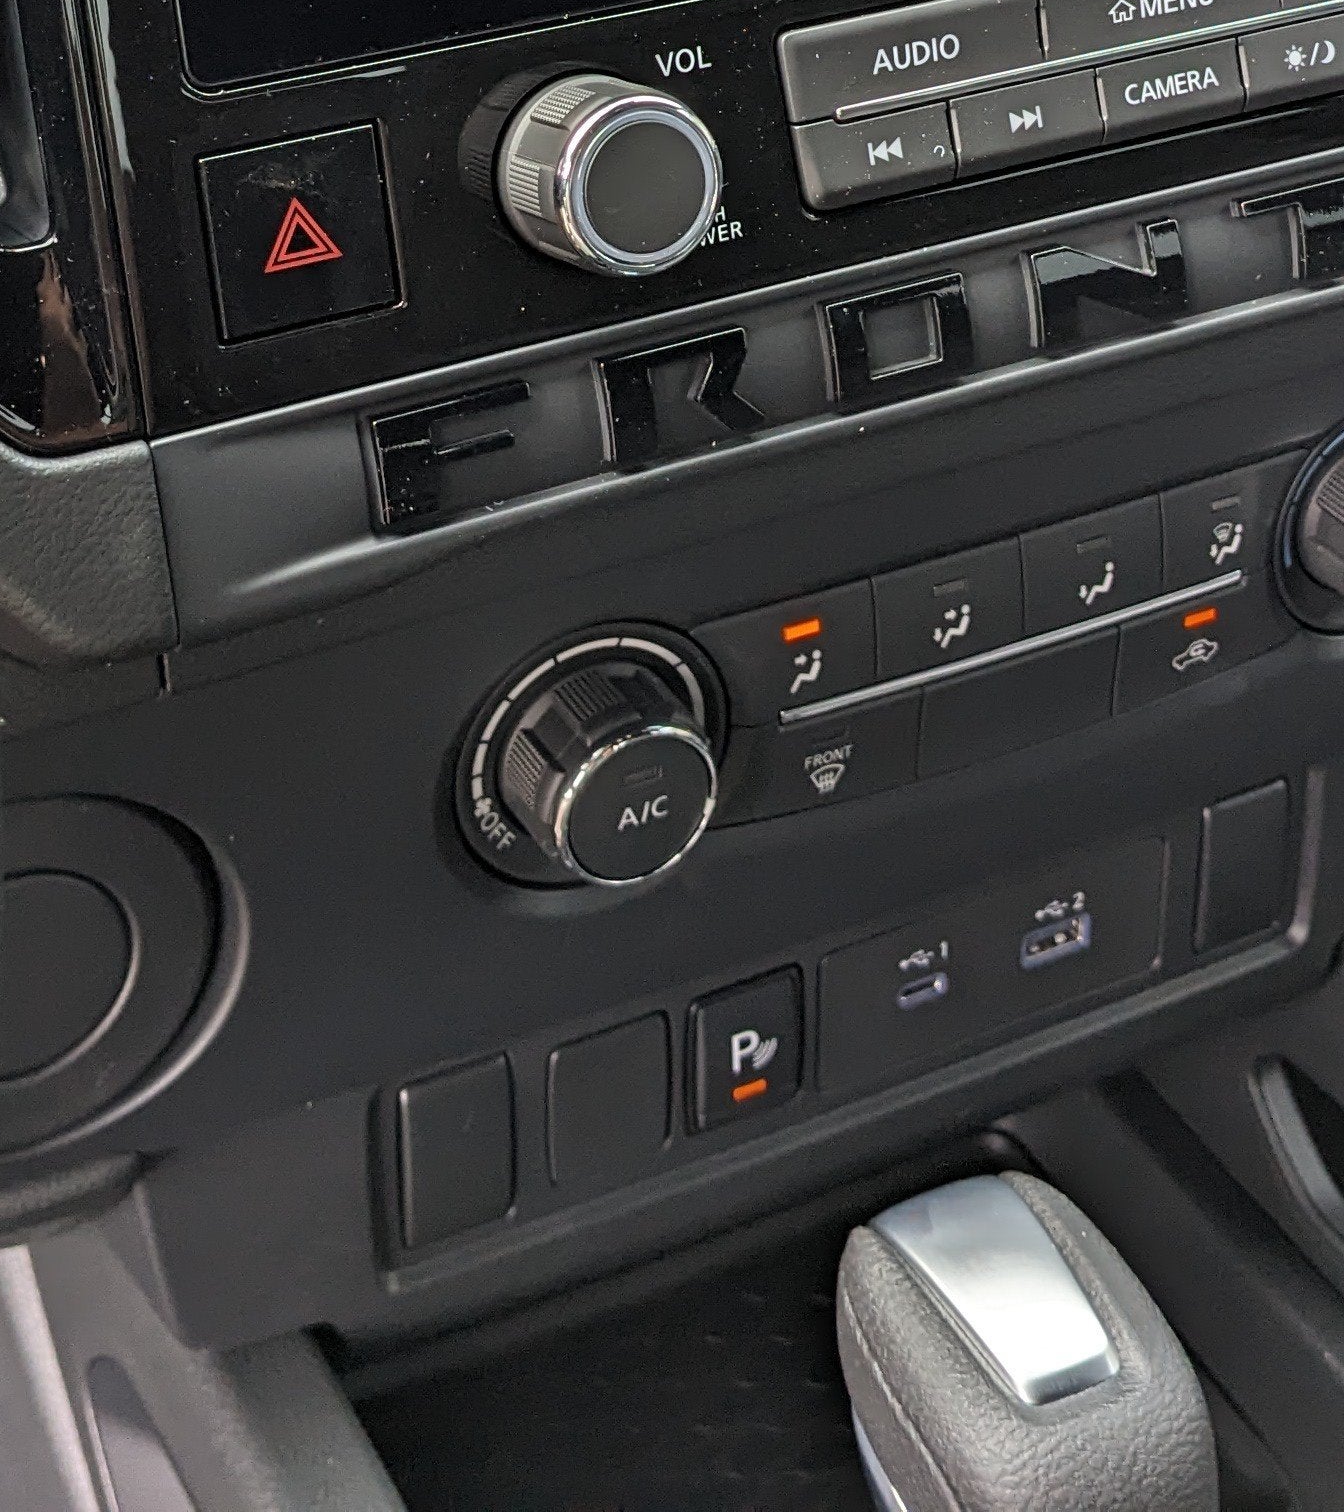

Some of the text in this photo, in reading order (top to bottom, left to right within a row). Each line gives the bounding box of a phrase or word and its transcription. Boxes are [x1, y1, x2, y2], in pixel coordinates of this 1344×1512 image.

[655, 45, 712, 78] VOL
[872, 33, 960, 75] AUDIO
[1124, 67, 1219, 106] CAMERA
[700, 221, 744, 247] WER
[804, 743, 855, 771] FRONT
[479, 810, 518, 852] OFF
[617, 793, 670, 832] A/C
